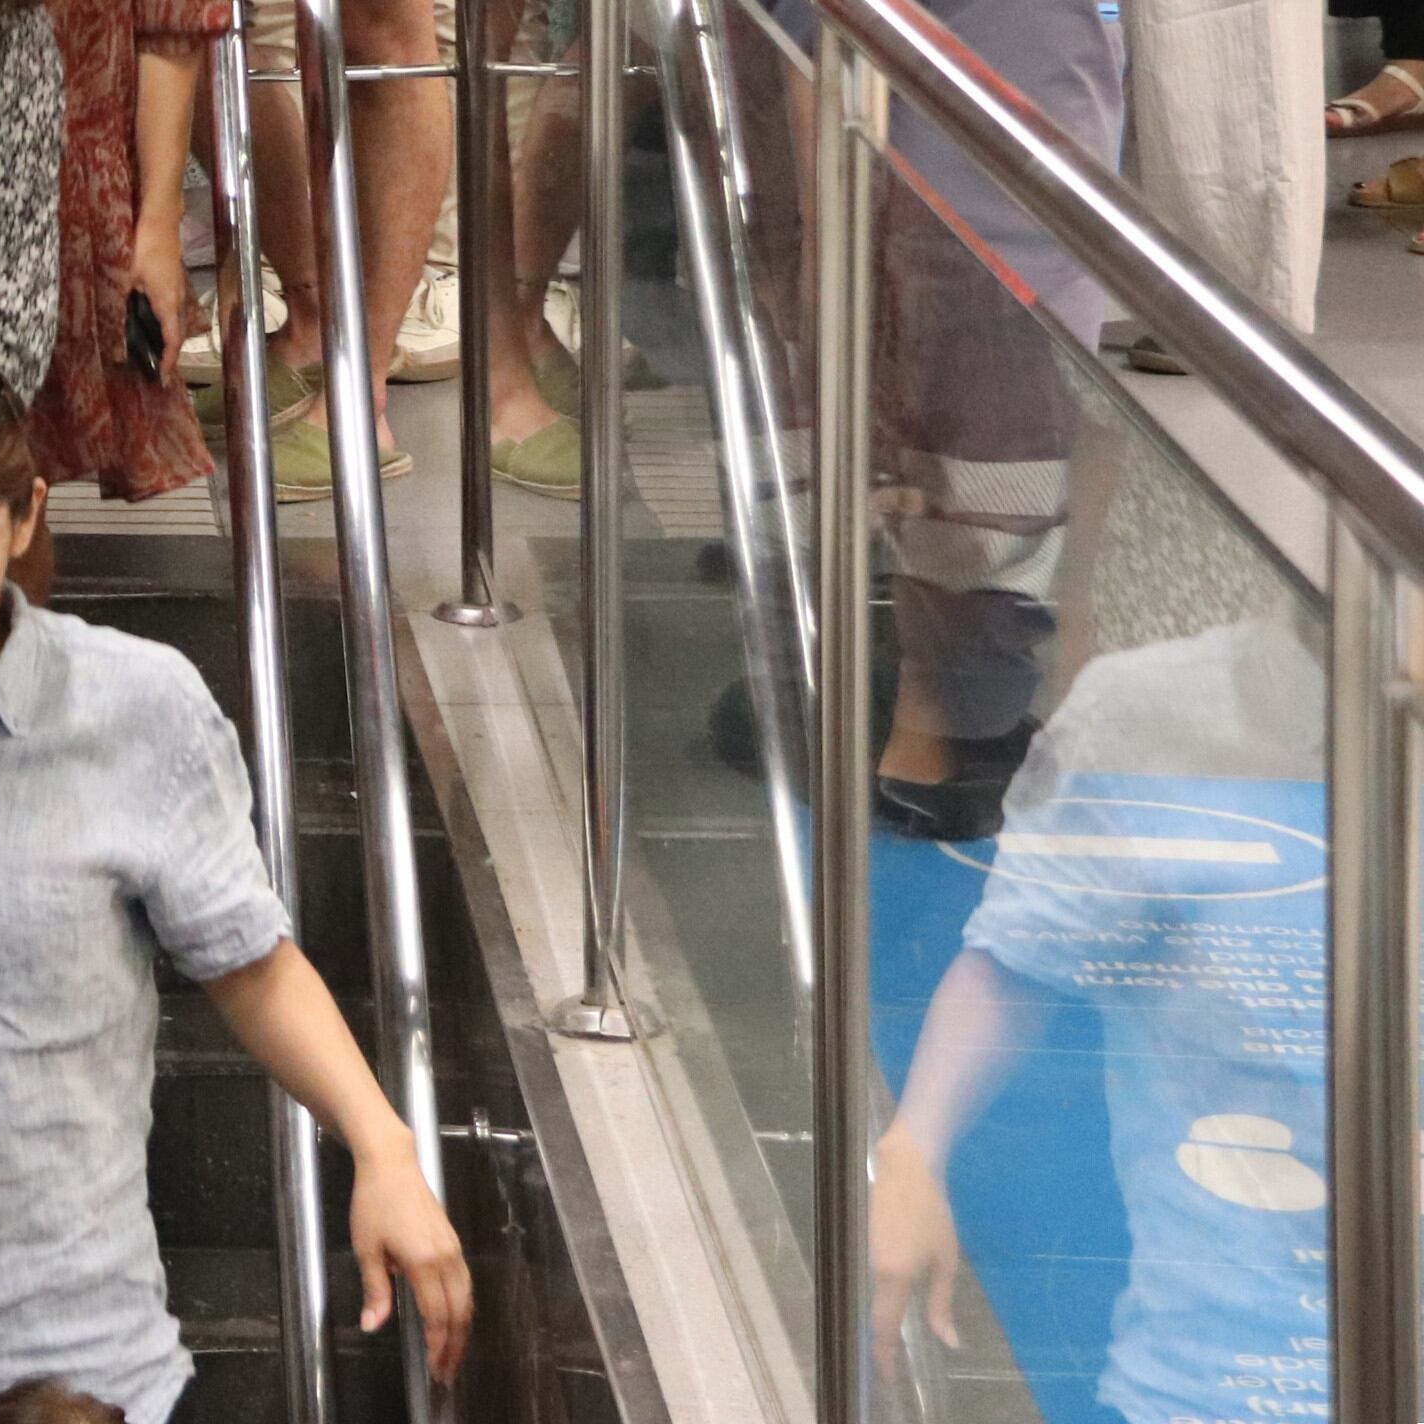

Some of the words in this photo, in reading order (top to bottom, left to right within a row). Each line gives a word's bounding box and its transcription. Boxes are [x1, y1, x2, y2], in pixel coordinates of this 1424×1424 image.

[1079, 959, 1278, 977] moment
[1071, 974, 1182, 989] torni
[1197, 978, 1289, 991] que
